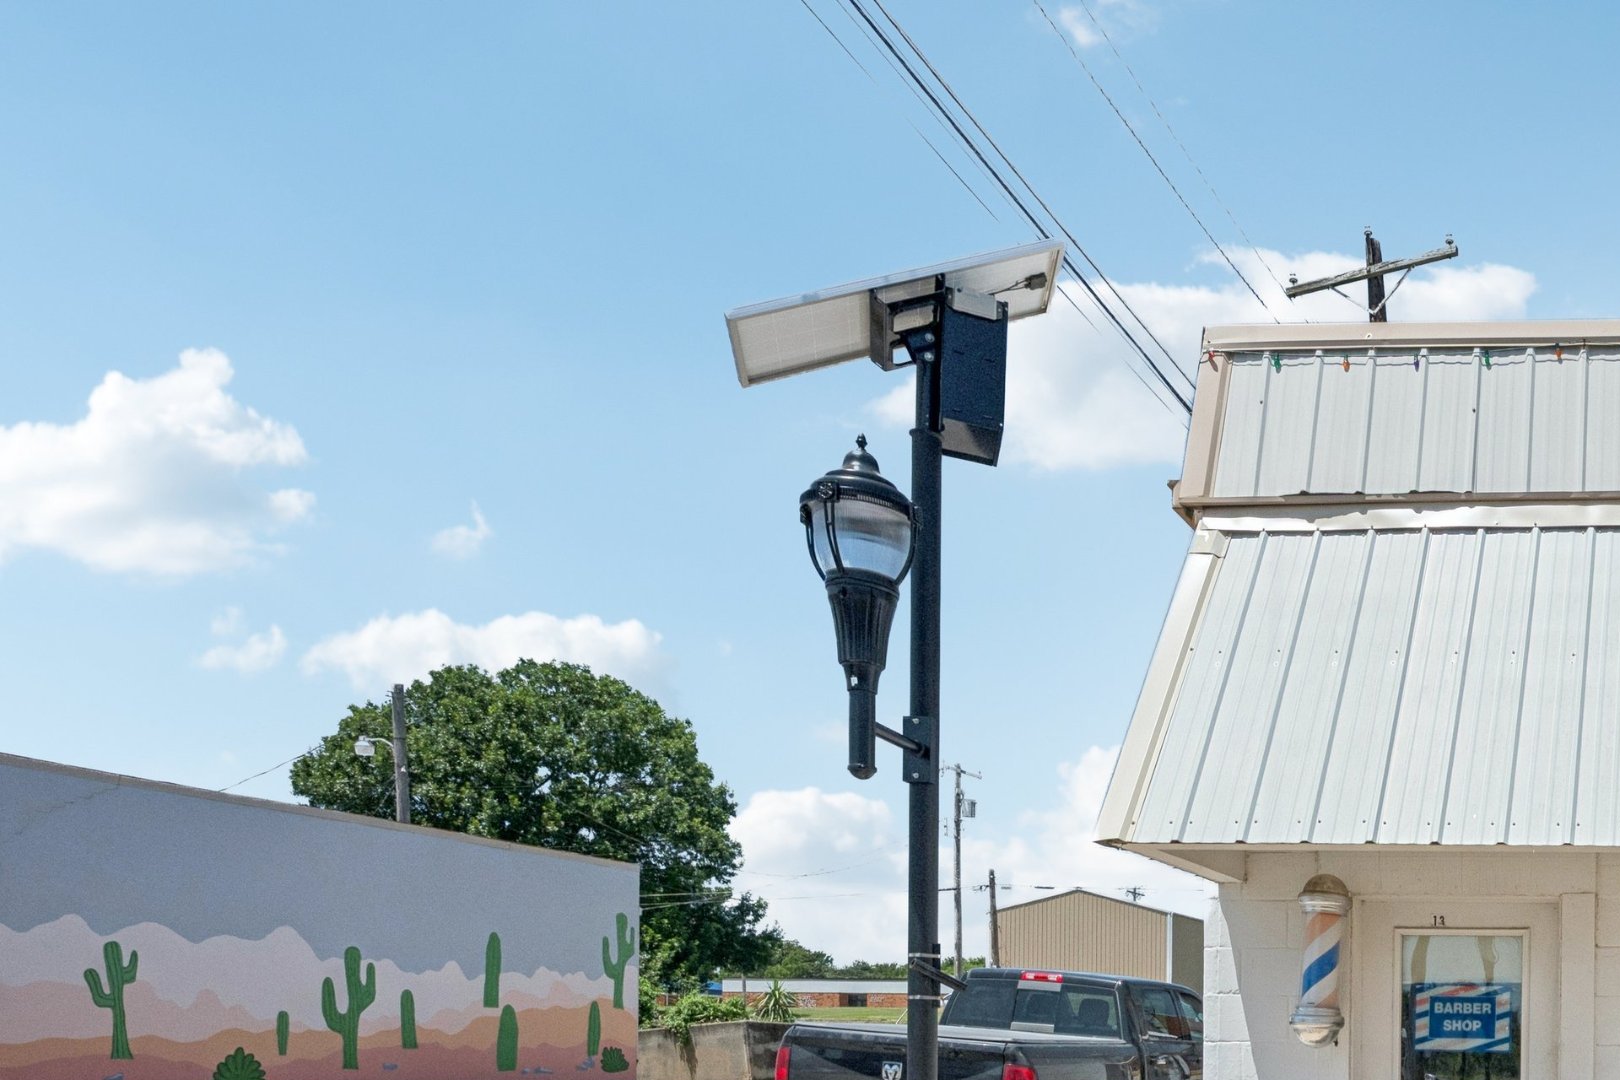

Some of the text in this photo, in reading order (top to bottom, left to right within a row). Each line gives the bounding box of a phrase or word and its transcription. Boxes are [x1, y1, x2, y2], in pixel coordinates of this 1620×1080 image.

[1433, 916, 1445, 926] 13
[1434, 1002, 1492, 1014] BARBER
[1443, 1020, 1482, 1032] SHOP
